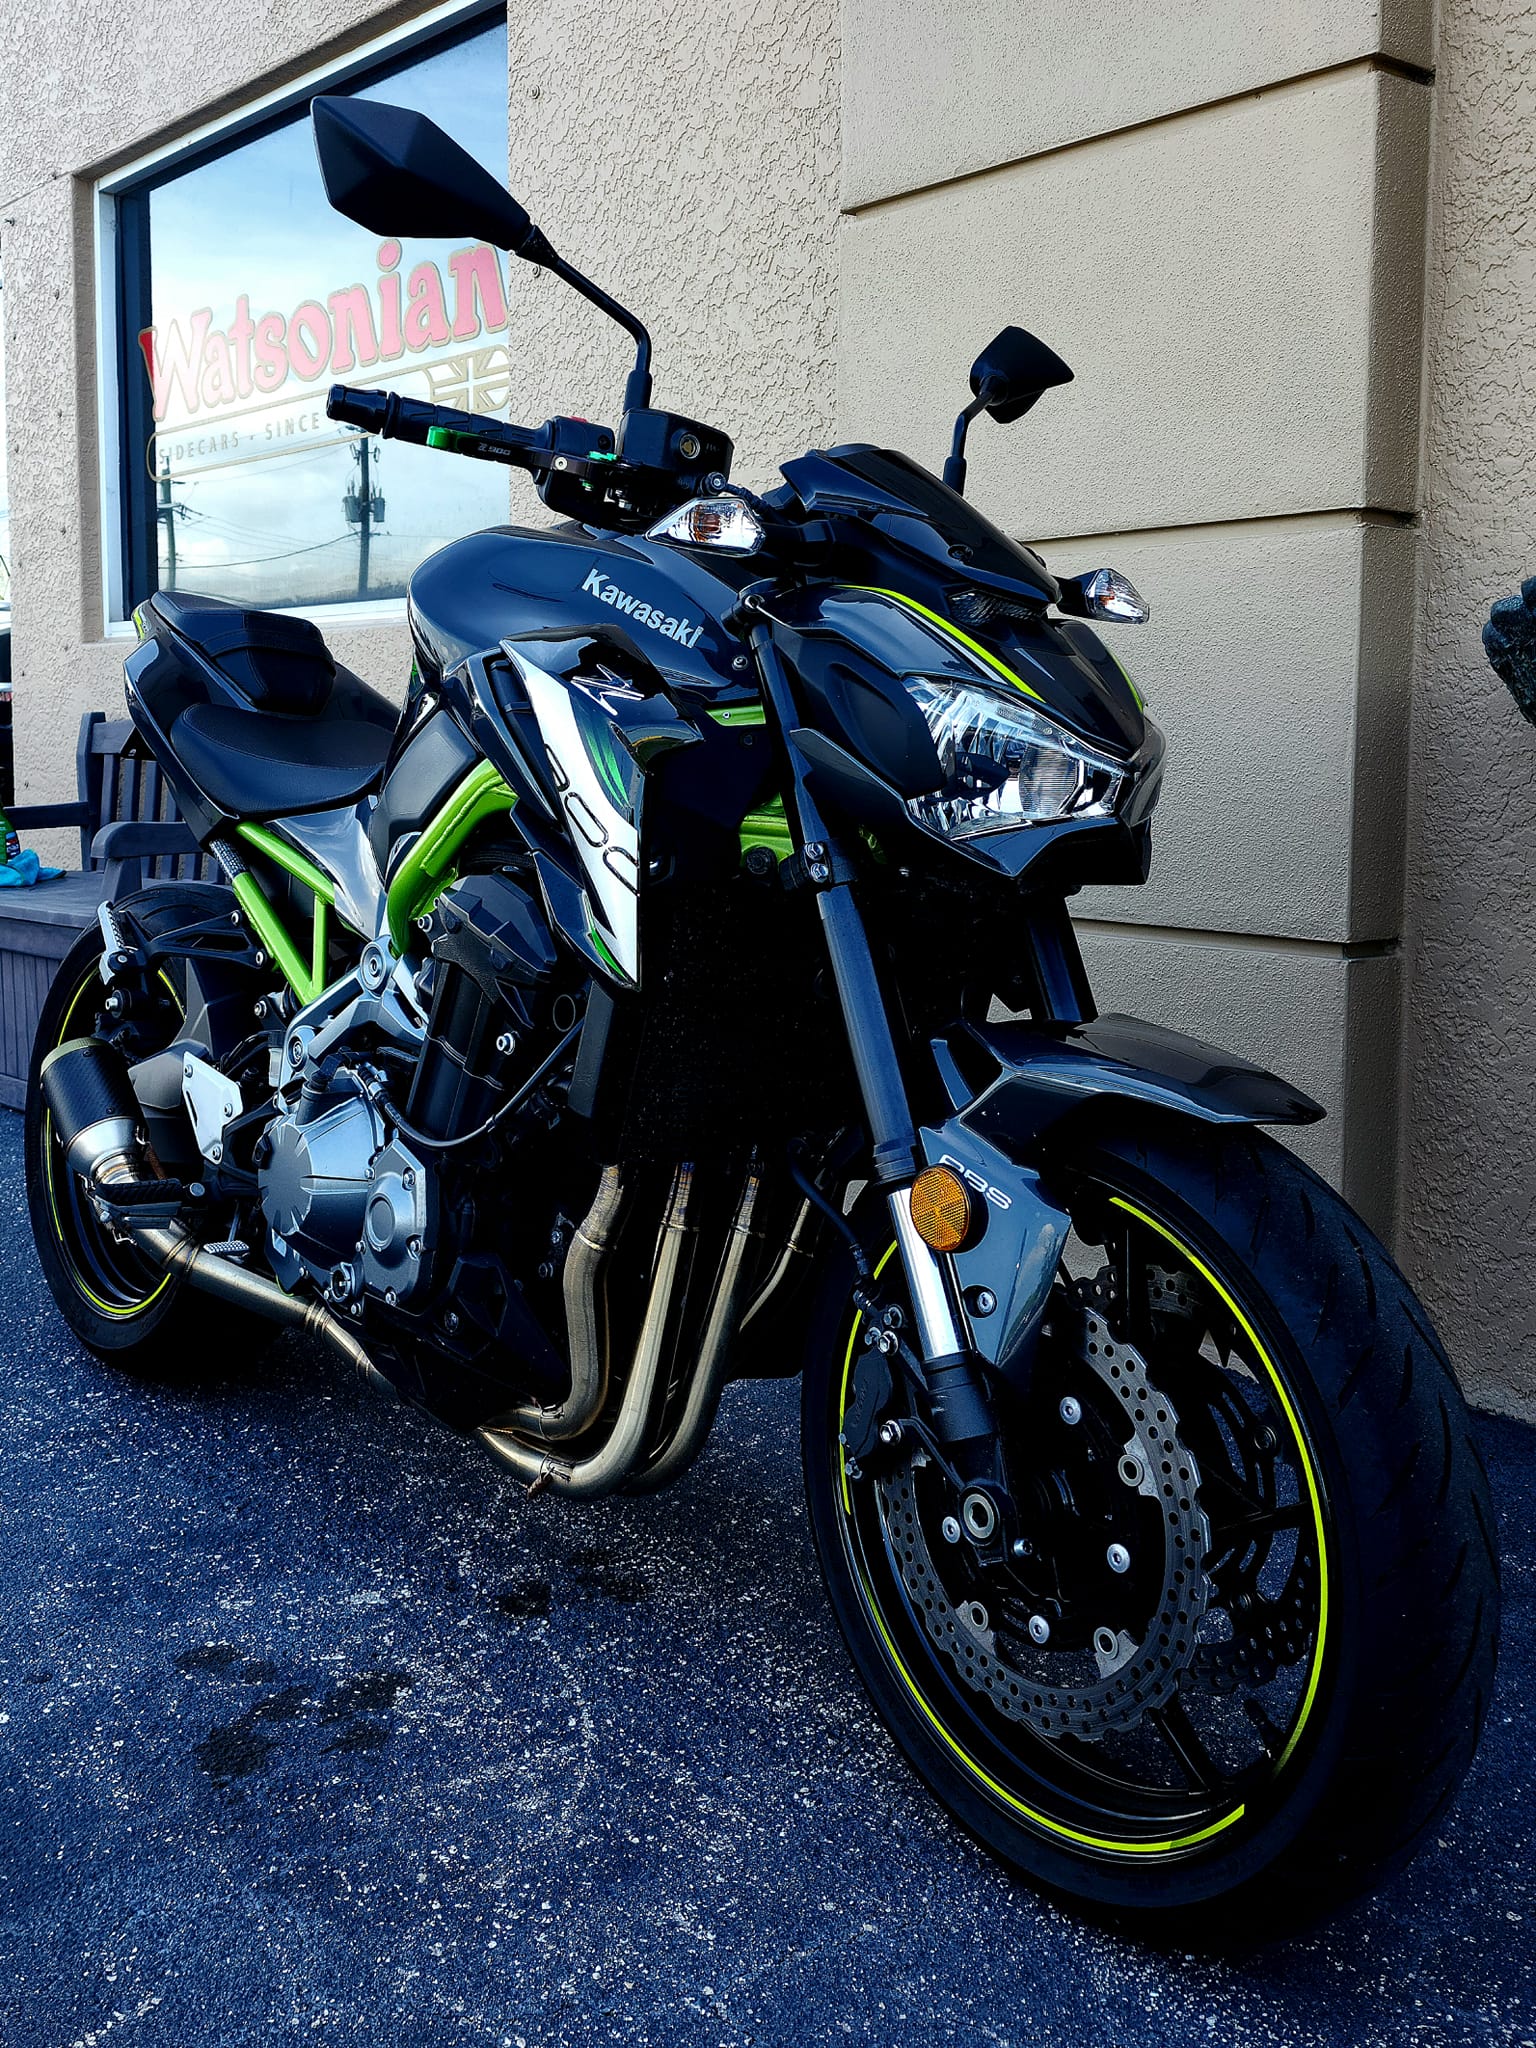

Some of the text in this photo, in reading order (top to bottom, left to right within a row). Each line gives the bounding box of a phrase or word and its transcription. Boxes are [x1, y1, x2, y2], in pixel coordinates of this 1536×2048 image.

[138, 238, 510, 422] Watsonian
[158, 412, 320, 465] SIDECARS SINCE
[581, 568, 704, 649] Kawasaki
